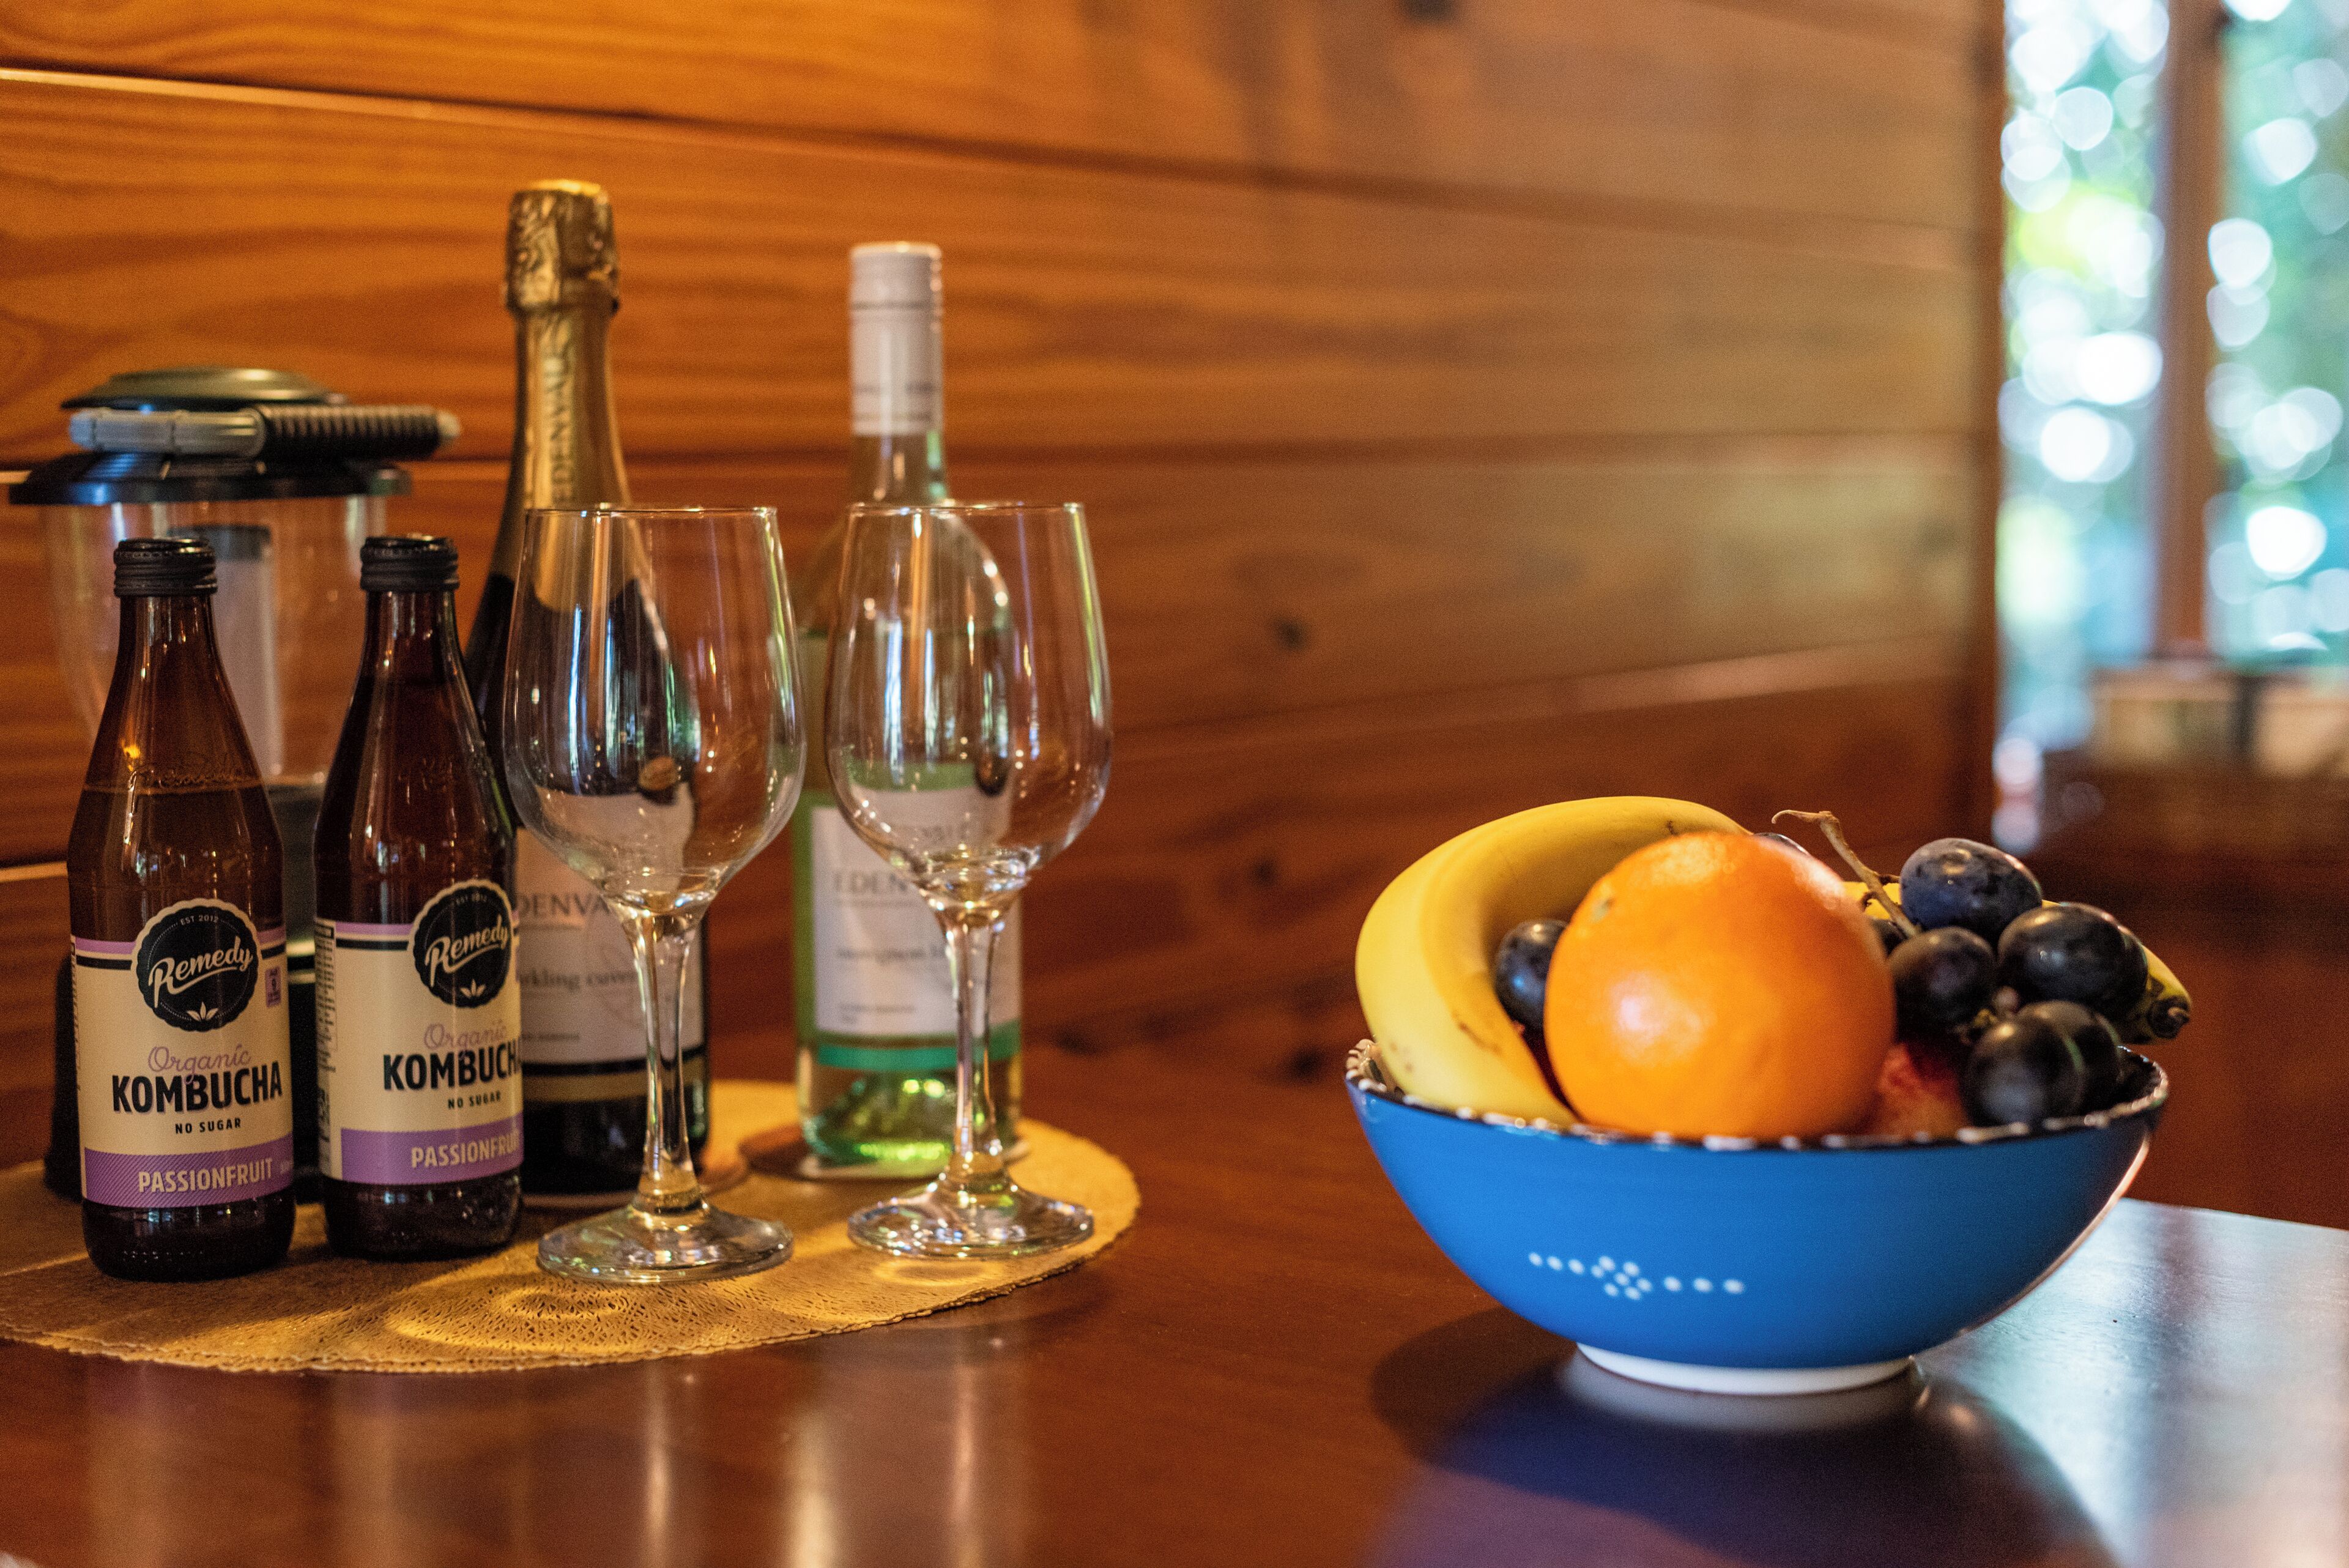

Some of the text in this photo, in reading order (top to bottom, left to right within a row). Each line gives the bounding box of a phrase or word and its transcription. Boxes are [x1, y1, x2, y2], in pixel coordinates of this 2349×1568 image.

[180, 913, 219, 926] EST 2012
[519, 892, 610, 918] DENVA
[425, 913, 508, 988] Remedy
[148, 935, 253, 1009] Remedy
[147, 1043, 253, 1085] Organic
[384, 1038, 520, 1091] KOMBUCH
[112, 1061, 284, 1115] KOMBUCHA
[448, 1090, 500, 1109] NO SUGAR
[175, 1118, 242, 1135] NO SUGAR
[138, 1157, 273, 1194] PASSIONFRUIT
